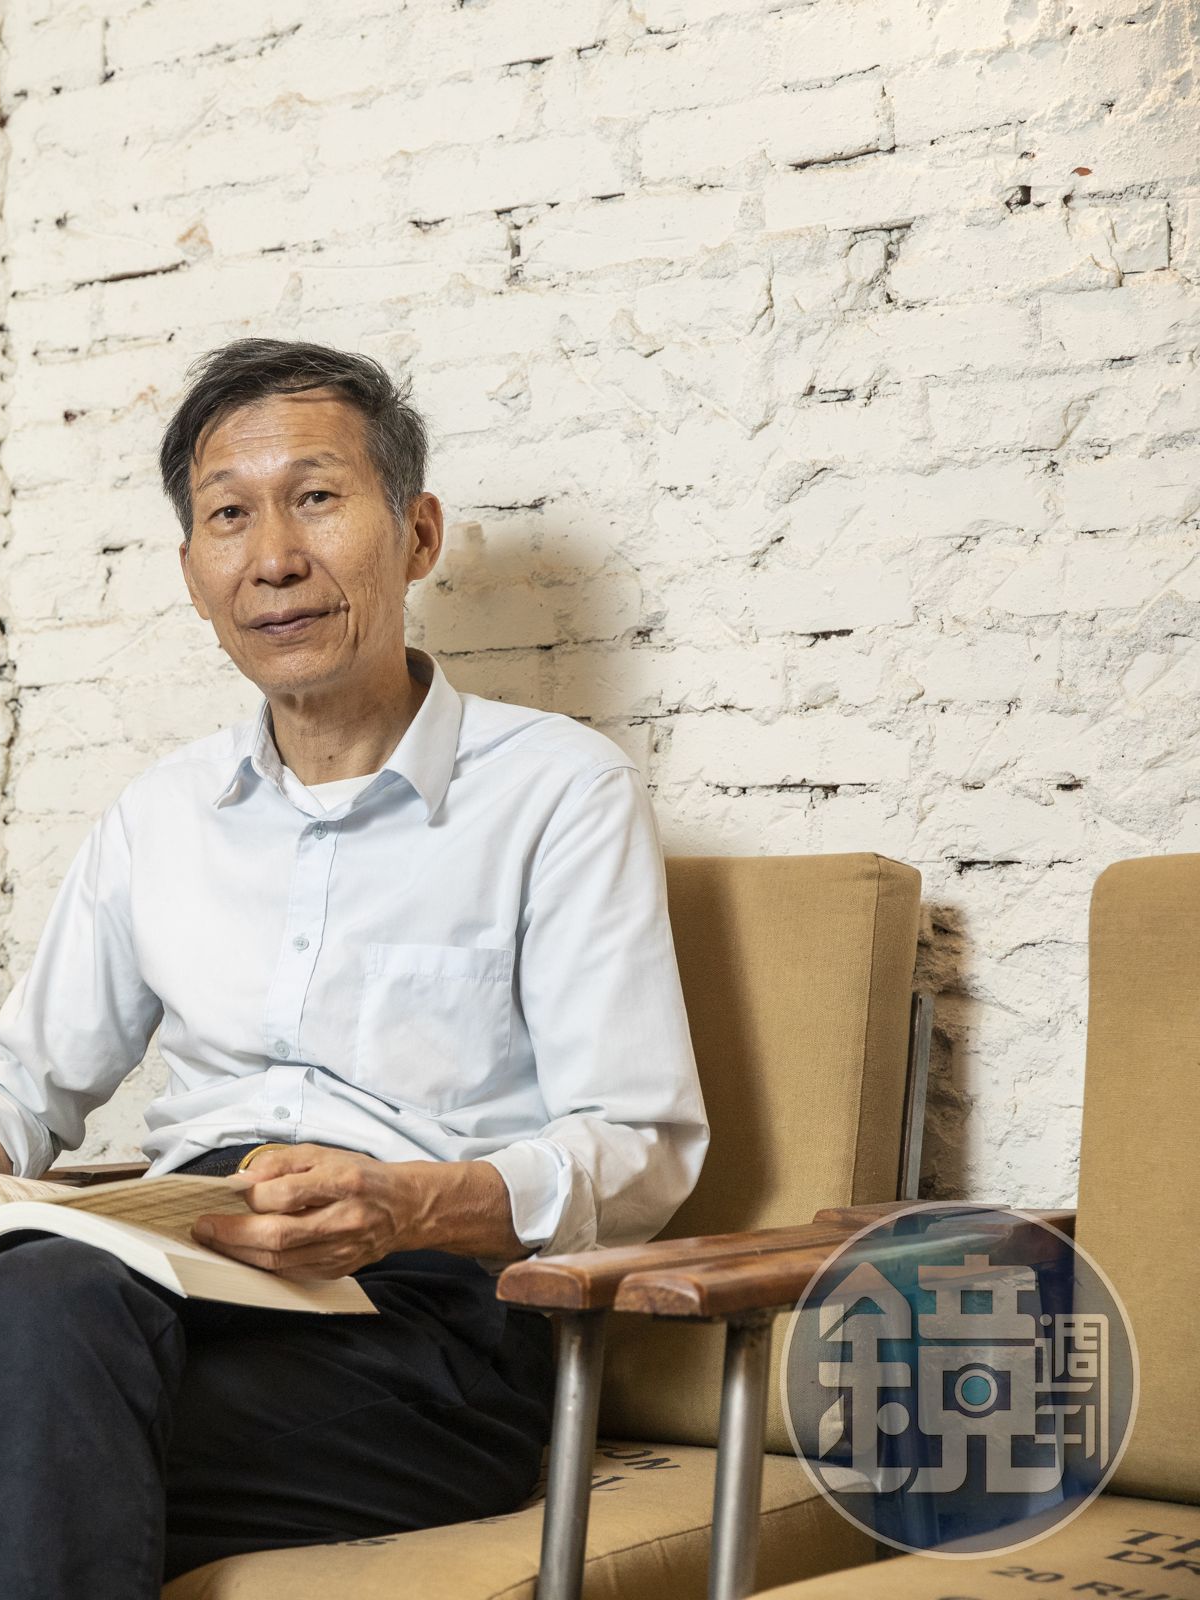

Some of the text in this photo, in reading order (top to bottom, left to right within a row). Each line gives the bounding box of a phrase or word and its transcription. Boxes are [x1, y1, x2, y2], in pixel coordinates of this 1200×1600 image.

[596, 1445, 681, 1470] ON
[990, 1566, 1187, 1600] 20 RU
